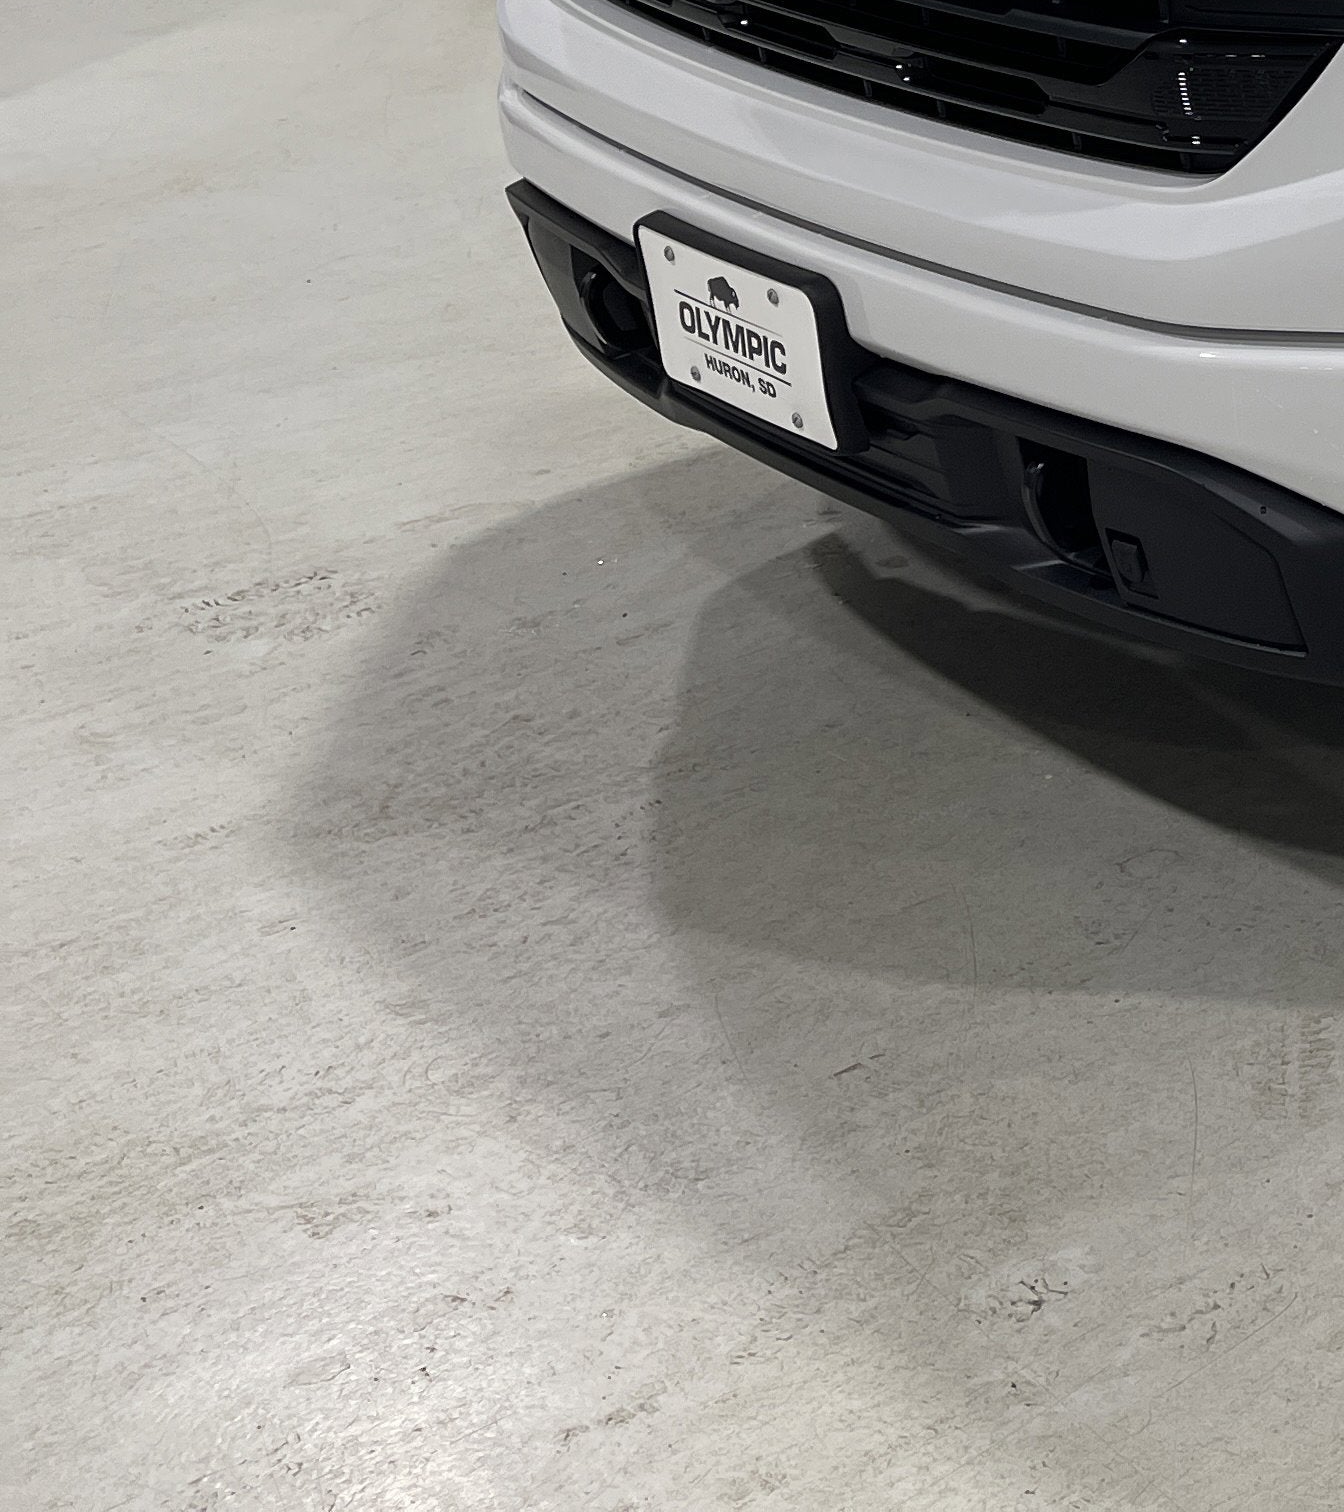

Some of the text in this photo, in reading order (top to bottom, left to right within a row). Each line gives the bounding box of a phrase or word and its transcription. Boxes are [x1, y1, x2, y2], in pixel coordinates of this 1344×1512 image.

[678, 300, 787, 376] OLYMPIC
[704, 352, 777, 399] HURON, SD
